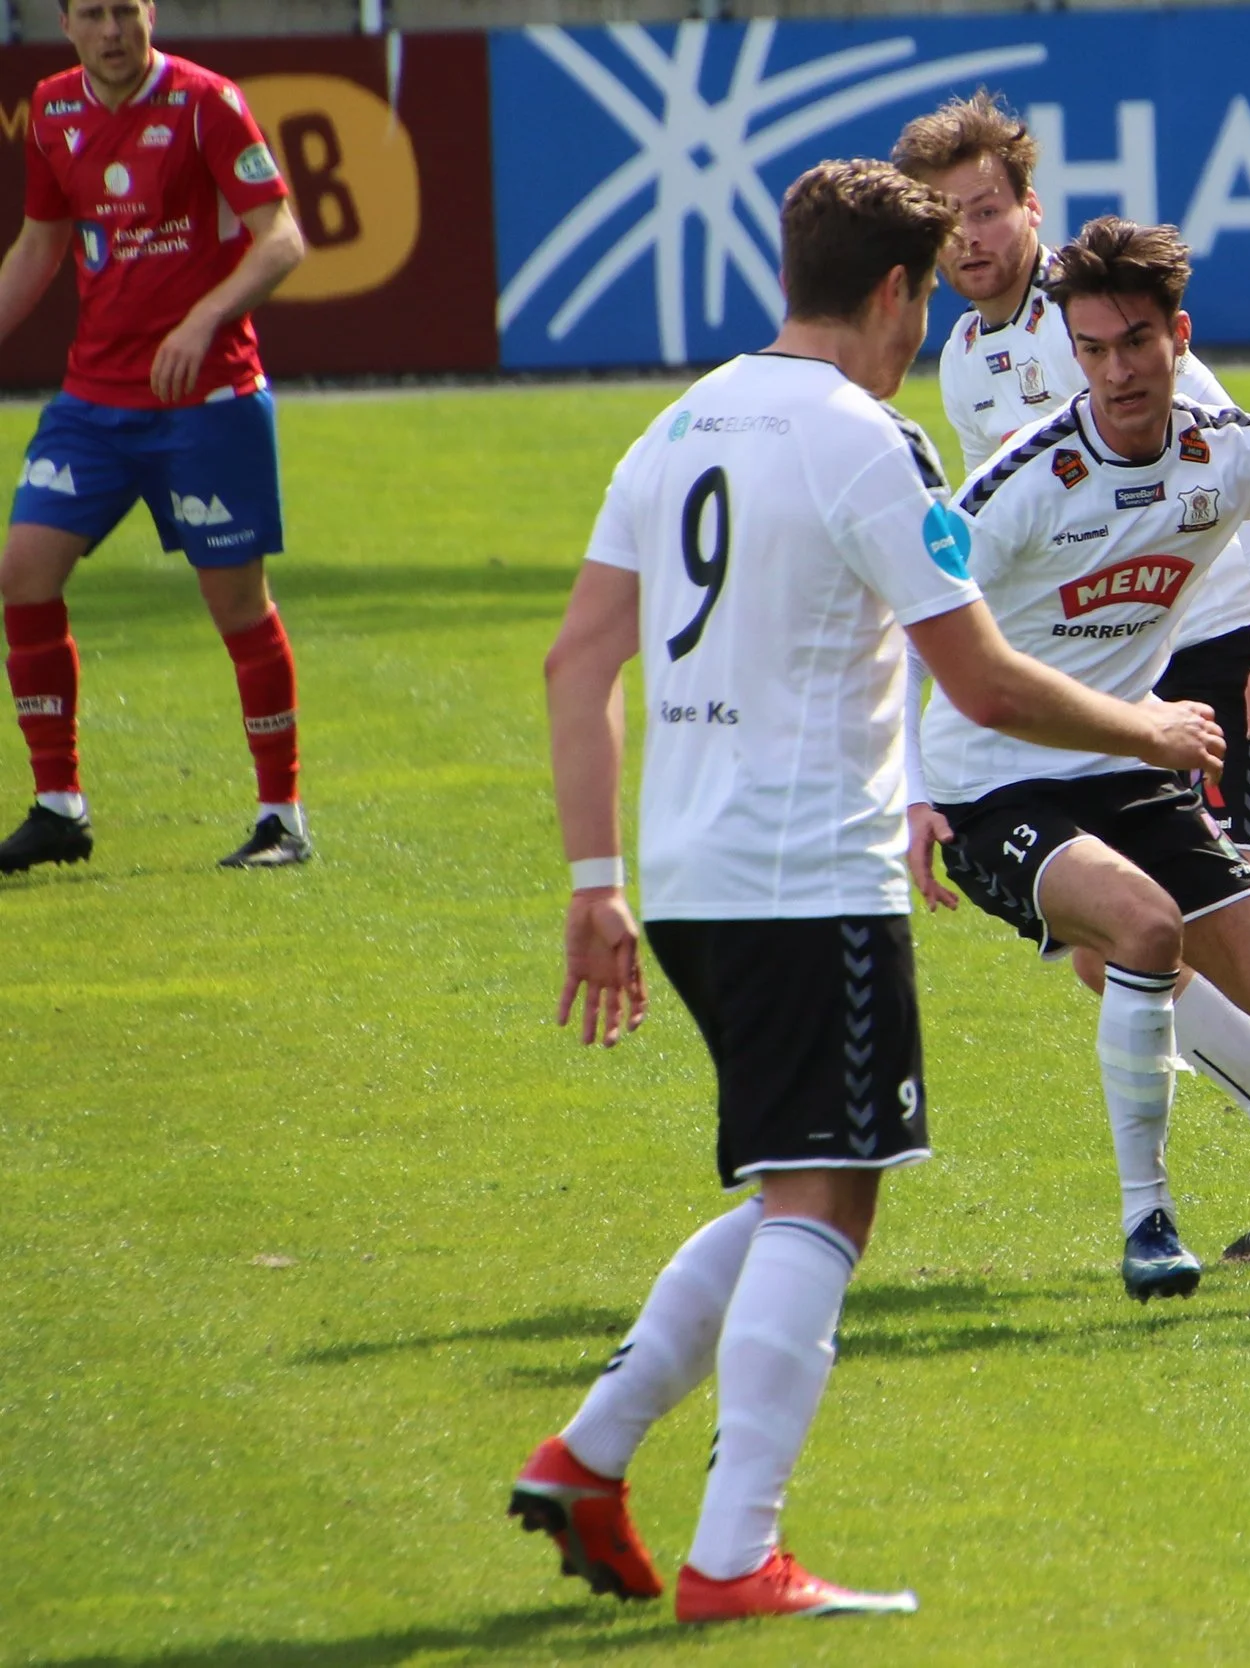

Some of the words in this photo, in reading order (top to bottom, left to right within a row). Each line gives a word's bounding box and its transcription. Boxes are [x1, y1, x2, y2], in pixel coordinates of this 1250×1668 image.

[1067, 524, 1109, 543] hummel
[666, 465, 730, 662] 9
[1077, 565, 1182, 607] MENY
[1003, 823, 1038, 864] 13
[898, 1079, 918, 1120] 9
